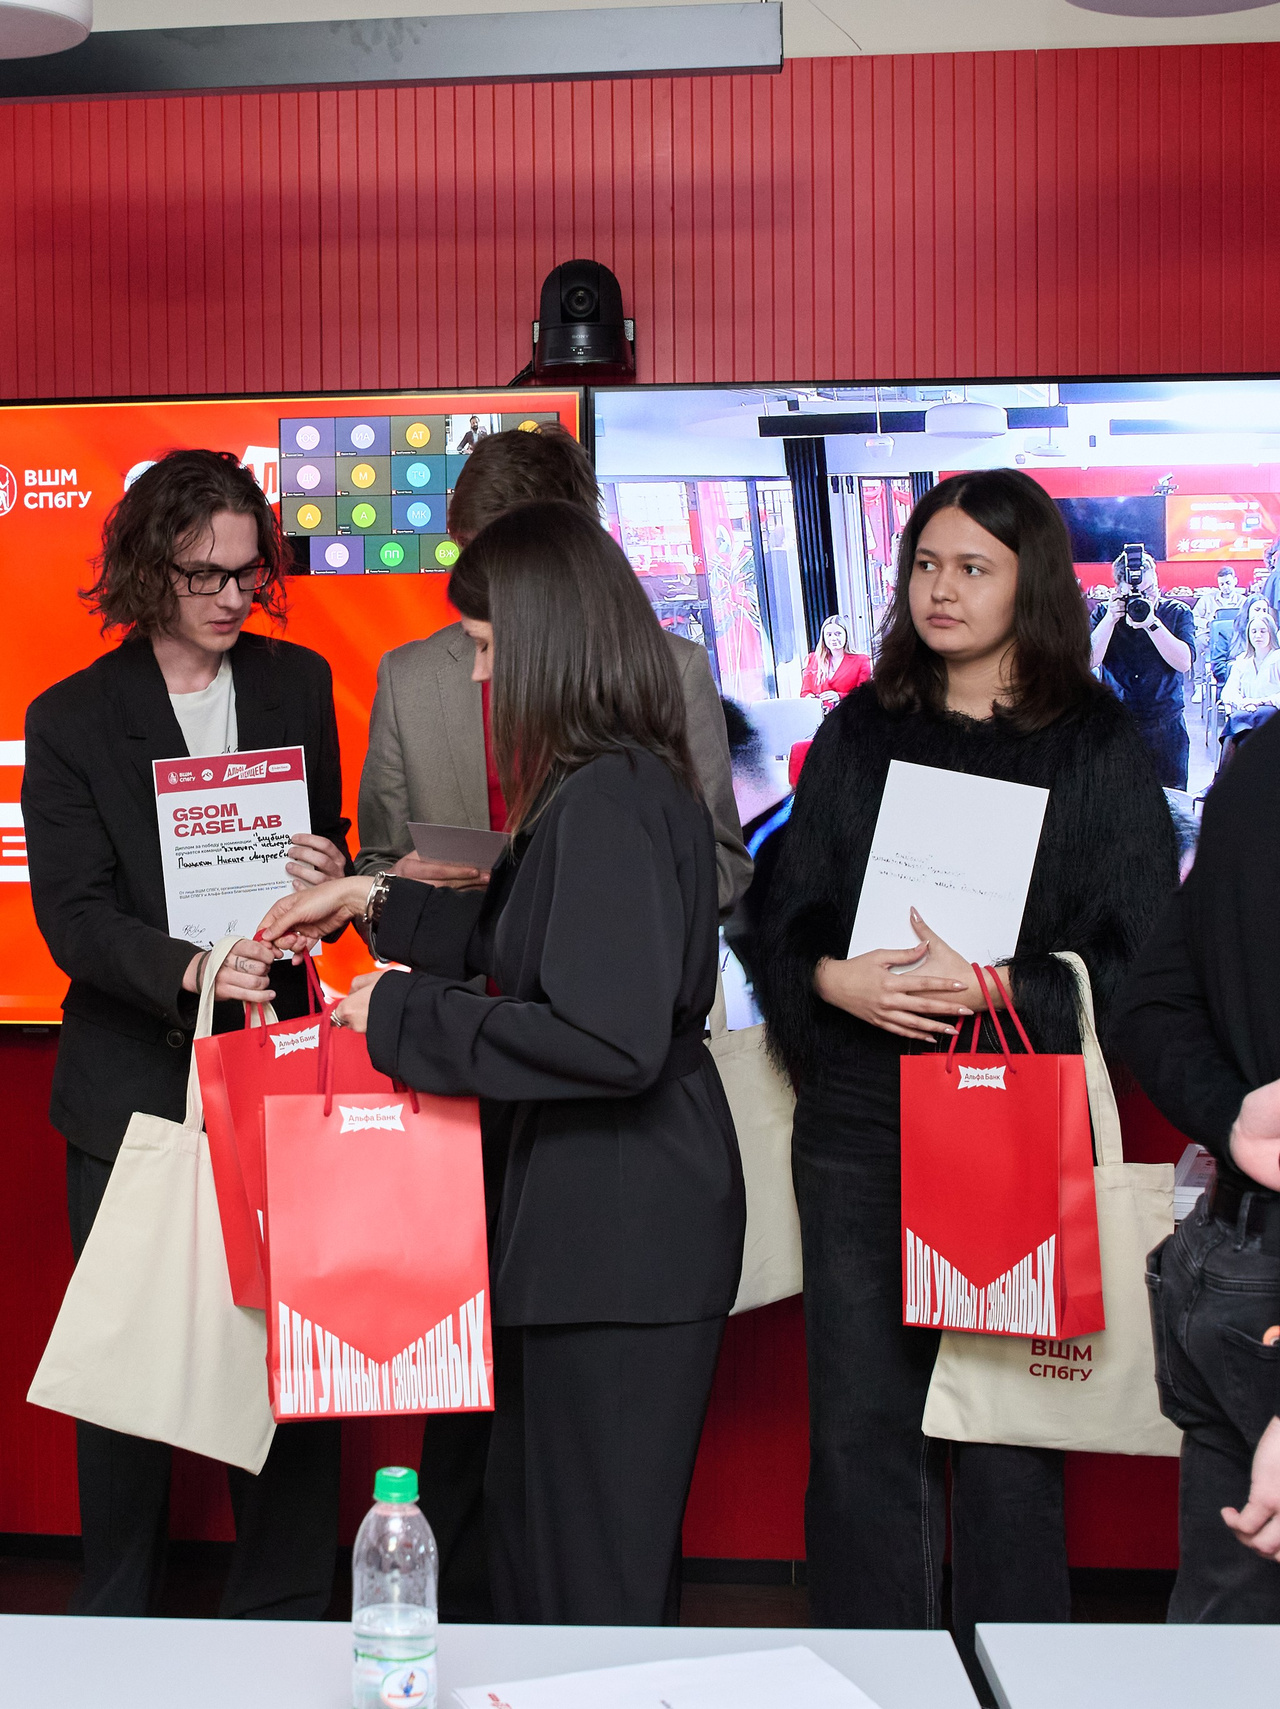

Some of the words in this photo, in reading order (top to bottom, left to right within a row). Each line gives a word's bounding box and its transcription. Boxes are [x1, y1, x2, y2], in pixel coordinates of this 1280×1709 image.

[355, 431, 370, 441] ИА
[411, 430, 425, 440] АТ
[24, 468, 78, 487] ВШМ
[301, 473, 316, 483] ДК
[358, 472, 368, 481] М
[23, 490, 93, 510] СПбГУ
[305, 512, 314, 521] А
[359, 511, 368, 520] А
[411, 510, 427, 519] МК
[384, 550, 400, 559] ПП
[439, 550, 456, 559] ВЖ
[172, 802, 238, 821] GSOM
[174, 819, 235, 837] CASE
[238, 814, 281, 830] LAB
[217, 853, 244, 864] Никите
[278, 1037, 300, 1049] Альфа
[299, 1034, 317, 1043] Банк
[964, 1073, 985, 1081] Альфа
[984, 1073, 1001, 1081] Банк
[348, 1114, 375, 1123] Альфа
[375, 1113, 397, 1122] Банк
[905, 1227, 931, 1325] ДЛЯ
[932, 1248, 979, 1330] УМНЫХ
[985, 1233, 1057, 1337] СВОБОДНЫХ
[278, 1300, 316, 1415] ДЛЯ
[314, 1322, 381, 1414] УМНЫХ
[391, 1289, 491, 1411] СВОБОДНЫХ
[1031, 1339, 1093, 1362] ВШМ
[1028, 1363, 1093, 1382] СПбГУ
